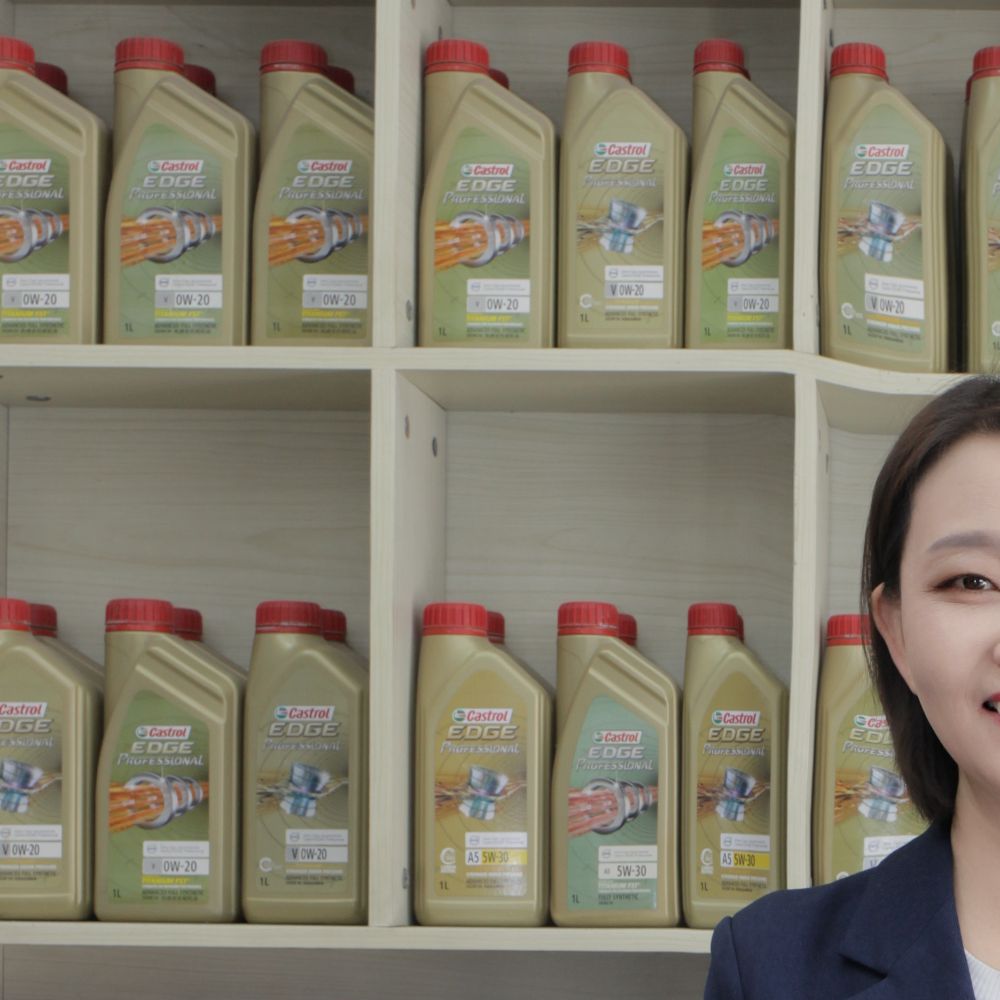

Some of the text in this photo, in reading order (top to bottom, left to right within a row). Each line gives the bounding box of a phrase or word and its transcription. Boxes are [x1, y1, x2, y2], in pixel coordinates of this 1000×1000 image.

[607, 144, 647, 156] Castrol
[867, 146, 906, 158] Castrol
[8, 160, 47, 170] Castrol
[160, 161, 200, 172] Castrol
[309, 161, 348, 172] Castrol
[473, 165, 510, 176] Castrol
[588, 160, 655, 173] EDGE
[734, 165, 763, 176] Castrol
[850, 162, 913, 175] EDGE
[144, 176, 205, 187] EDGE
[292, 176, 353, 187] EDGE
[456, 180, 517, 192] EDGE
[720, 180, 768, 191] EDGE
[619, 284, 644, 296] 0W-20
[22, 293, 57, 305] 0W-20
[176, 294, 210, 305] 0W-20
[323, 294, 356, 305] 0W-20
[486, 298, 518, 310] 0W-20
[743, 298, 769, 310] 0W-20
[879, 299, 904, 314] 0W-20
[288, 707, 330, 719] Castrol
[466, 710, 508, 722] Castrol
[723, 712, 757, 724] Castrol
[0, 719, 52, 732] DGE
[269, 723, 339, 737] EDGE
[148, 727, 187, 738] Castrol
[447, 726, 517, 740] EDGE
[603, 732, 638, 743] Castrol
[707, 728, 763, 742] EDGE
[131, 742, 192, 753] EDGE
[588, 746, 645, 758] EDGE
[12, 845, 40, 856] 0W-20
[301, 848, 327, 860] 0W-20
[482, 851, 509, 863] 5W-30
[734, 854, 755, 867] 5W-30
[163, 861, 197, 872] 0W-20
[617, 866, 647, 877] 5W-30
